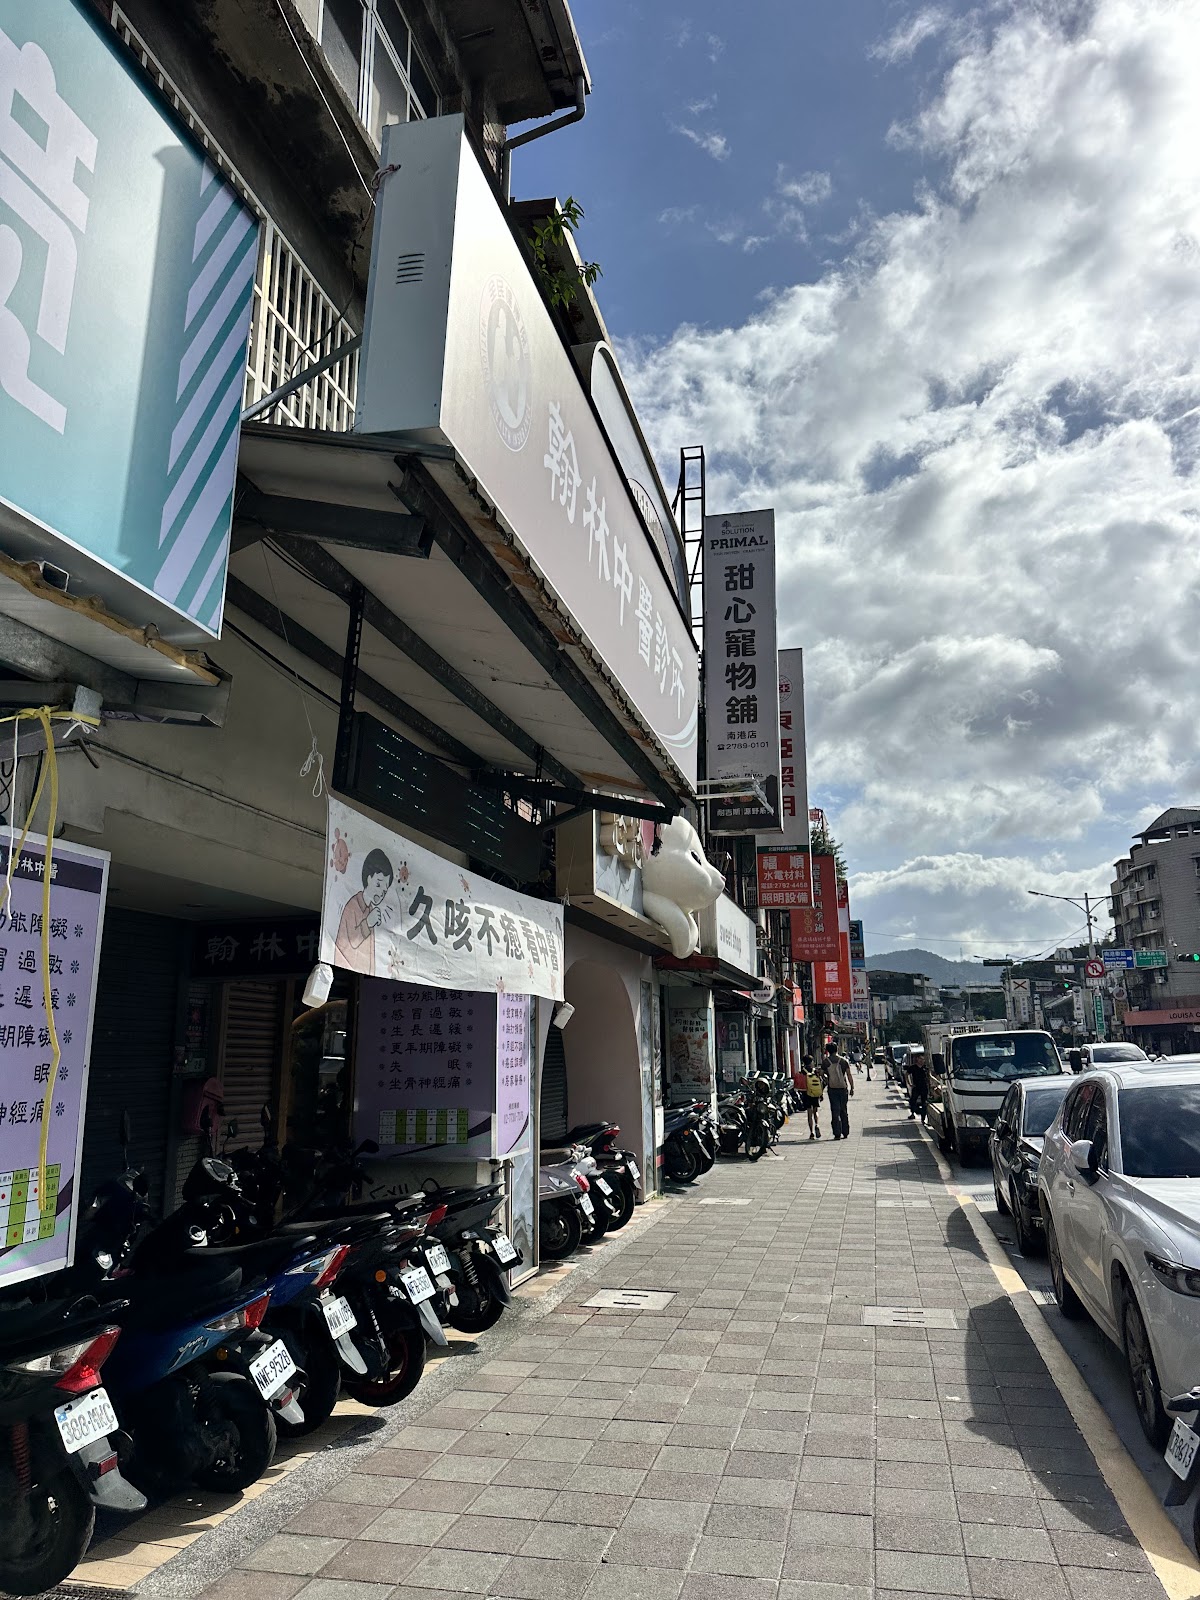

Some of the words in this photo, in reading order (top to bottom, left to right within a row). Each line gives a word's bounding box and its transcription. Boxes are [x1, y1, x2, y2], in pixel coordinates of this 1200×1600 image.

[721, 527, 755, 536] SOLUTION
[710, 535, 768, 550] PRIMAL
[726, 730, 757, 740] 南港店
[763, 870, 805, 881] 水電材料
[761, 892, 809, 904] 照明設備
[390, 1041, 462, 1055] 更年期障礙
[388, 1076, 461, 1090] 坐骨神經痛
